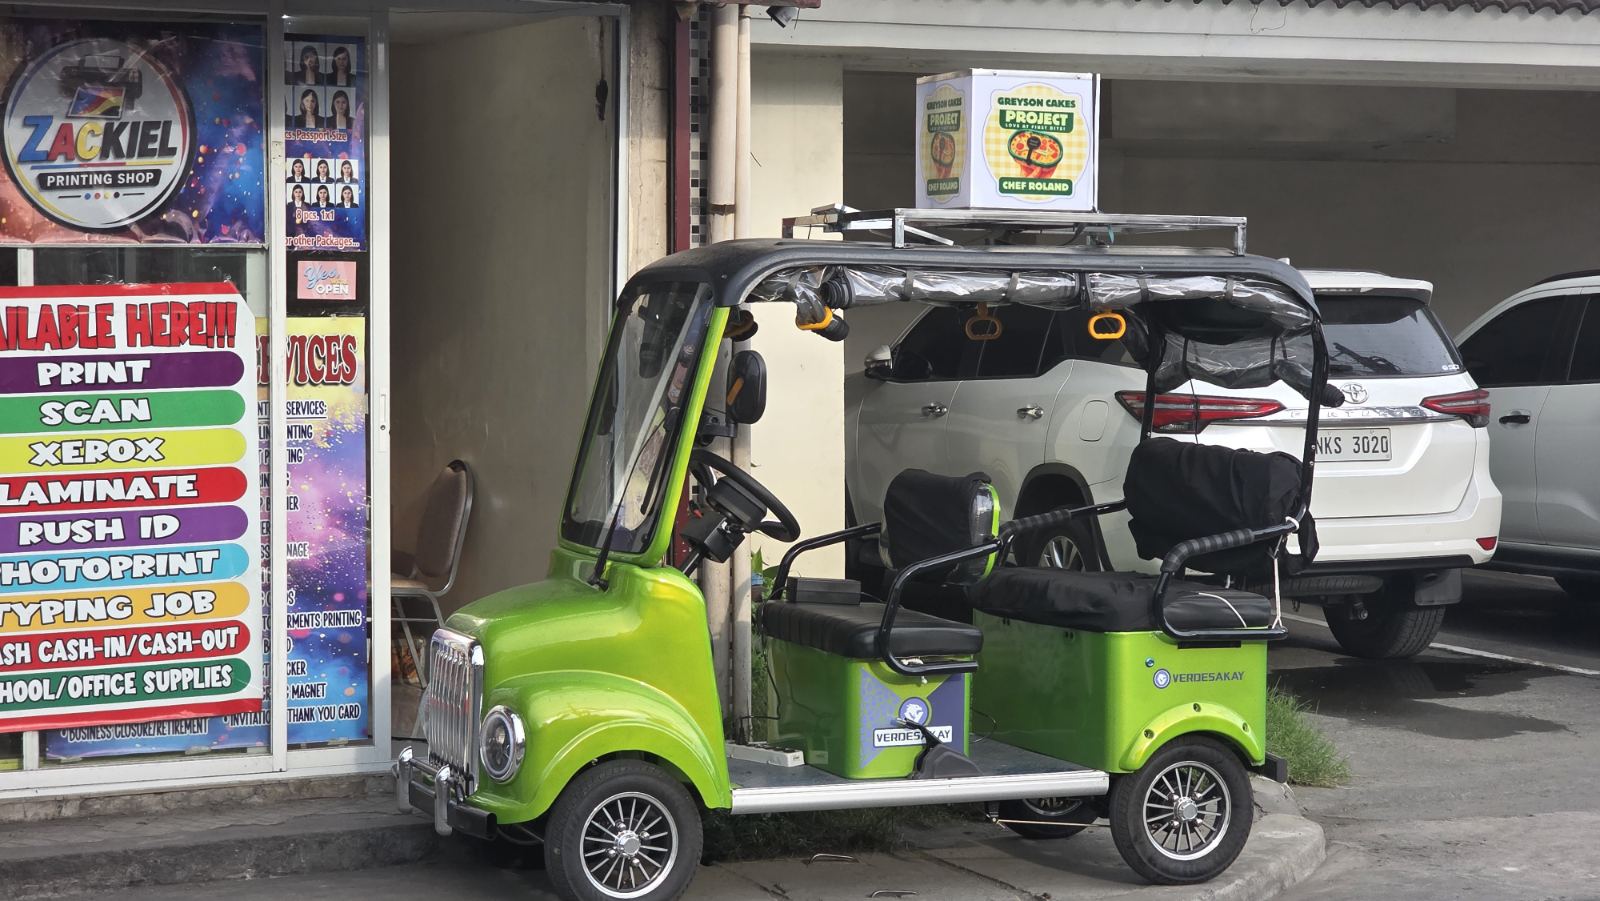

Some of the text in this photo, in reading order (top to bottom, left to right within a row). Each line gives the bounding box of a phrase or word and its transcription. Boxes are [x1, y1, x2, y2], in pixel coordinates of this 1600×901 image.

[997, 97, 1076, 109] GREYSON CAKES
[930, 112, 959, 126] PROJECT
[1005, 110, 1069, 127] PROJECT
[17, 115, 178, 163] ZACKIEL
[46, 172, 155, 188] PRINTING SHOP
[1002, 180, 1070, 192] CHEF ROLAND
[296, 209, 335, 222] 8 pcs. 1x1
[293, 235, 314, 246] other
[316, 235, 360, 250] Packages...
[316, 284, 349, 295] OPEN
[125, 301, 237, 348] HERE!!!
[36, 359, 151, 387] PRINT
[39, 398, 152, 426] SCAN
[286, 401, 327, 415] SERVICES:
[286, 425, 313, 439] NTING
[28, 437, 165, 467] XEROX
[1353, 436, 1389, 454] 3020
[0, 474, 198, 507] LAMINATE
[18, 514, 180, 546] RUSH ID
[0, 549, 220, 586] HOTOPRINT
[144, 590, 216, 618] JOB
[323, 611, 361, 627] PRINTING
[38, 626, 239, 664] CASH-IN/CASH-OUT
[143, 664, 233, 694] SUPPLIES
[1173, 671, 1245, 683] VERDESAKAY
[291, 683, 326, 699] MAGNET
[288, 707, 315, 723] THANK
[317, 706, 336, 720] YOU
[338, 704, 360, 719] CARD
[876, 730, 951, 742] VERDESAY
